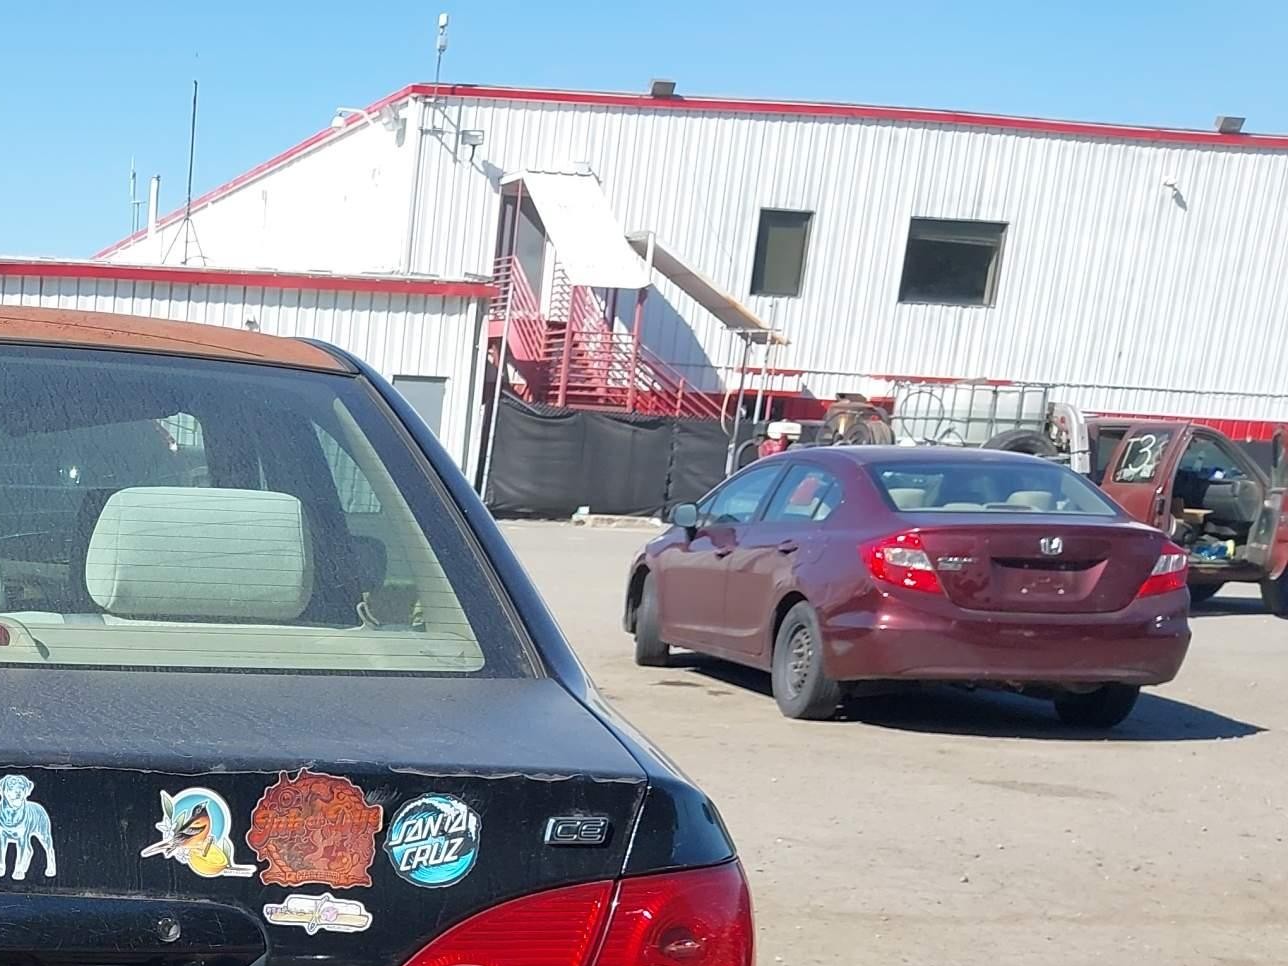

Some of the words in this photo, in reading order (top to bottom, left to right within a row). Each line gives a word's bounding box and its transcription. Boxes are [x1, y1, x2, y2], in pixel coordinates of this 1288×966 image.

[388, 809, 467, 846] SANTA
[554, 821, 605, 841] CE
[400, 838, 465, 871] CRUZ
